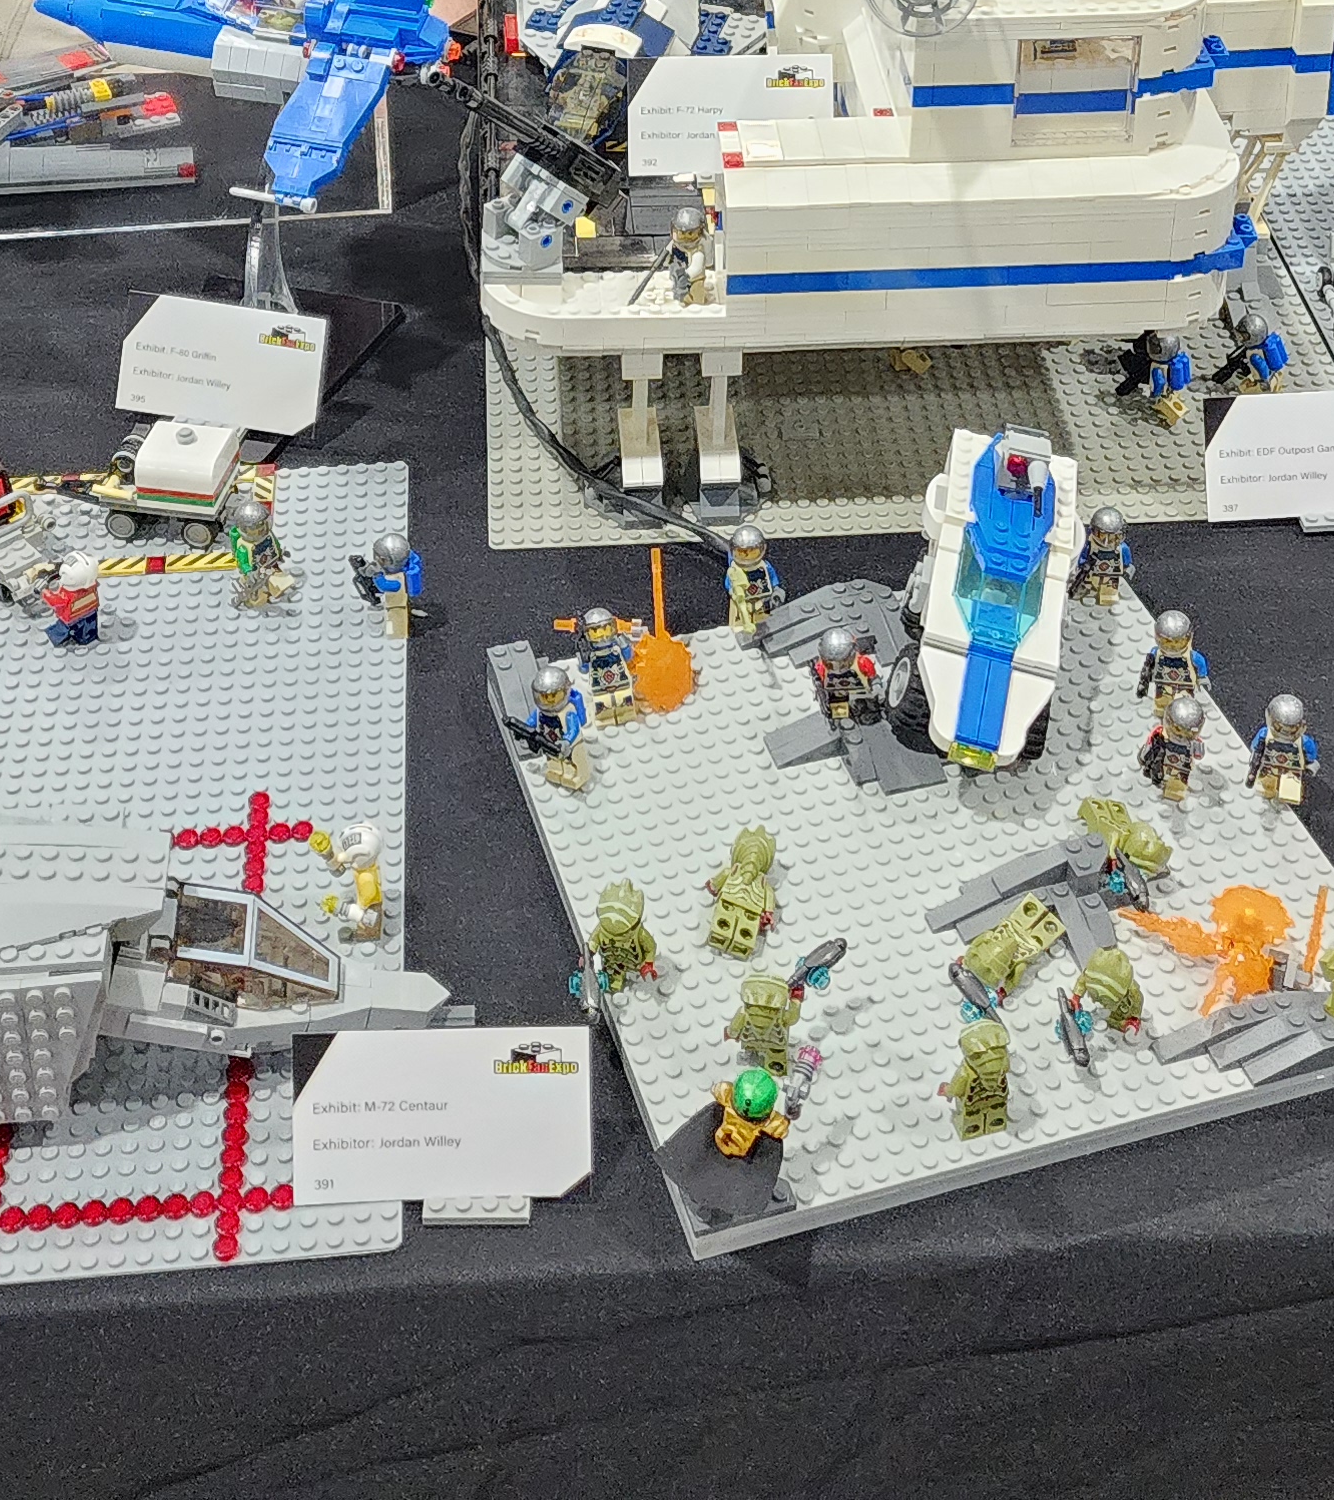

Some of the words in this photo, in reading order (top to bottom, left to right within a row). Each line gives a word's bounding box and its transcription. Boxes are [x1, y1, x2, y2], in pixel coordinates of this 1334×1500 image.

[640, 106, 674, 116] Exhibit:
[697, 105, 724, 116] Harpy
[640, 130, 684, 140] Exhibitor:
[685, 130, 716, 140] Jordan
[135, 341, 167, 355] Exhibit:
[191, 349, 218, 363] Griffin
[132, 366, 175, 382] Exhibitor:
[175, 373, 205, 387] Jordan
[205, 377, 232, 392] Willey
[1218, 448, 1254, 460] Exhibit:
[1255, 447, 1276, 457] EDF
[1277, 445, 1315, 456] Outpost
[1219, 474, 1266, 485] Exhibitor:
[1267, 473, 1299, 484] Jordan
[1299, 471, 1329, 482] Willey
[312, 1101, 361, 1116] Exhibit:
[363, 1100, 396, 1113] M-72
[398, 1099, 449, 1113] Centaur
[312, 1137, 375, 1152] Exhibitor:
[378, 1136, 421, 1150] Jordan
[423, 1135, 463, 1150] Willey
[313, 1178, 335, 1191] 391
